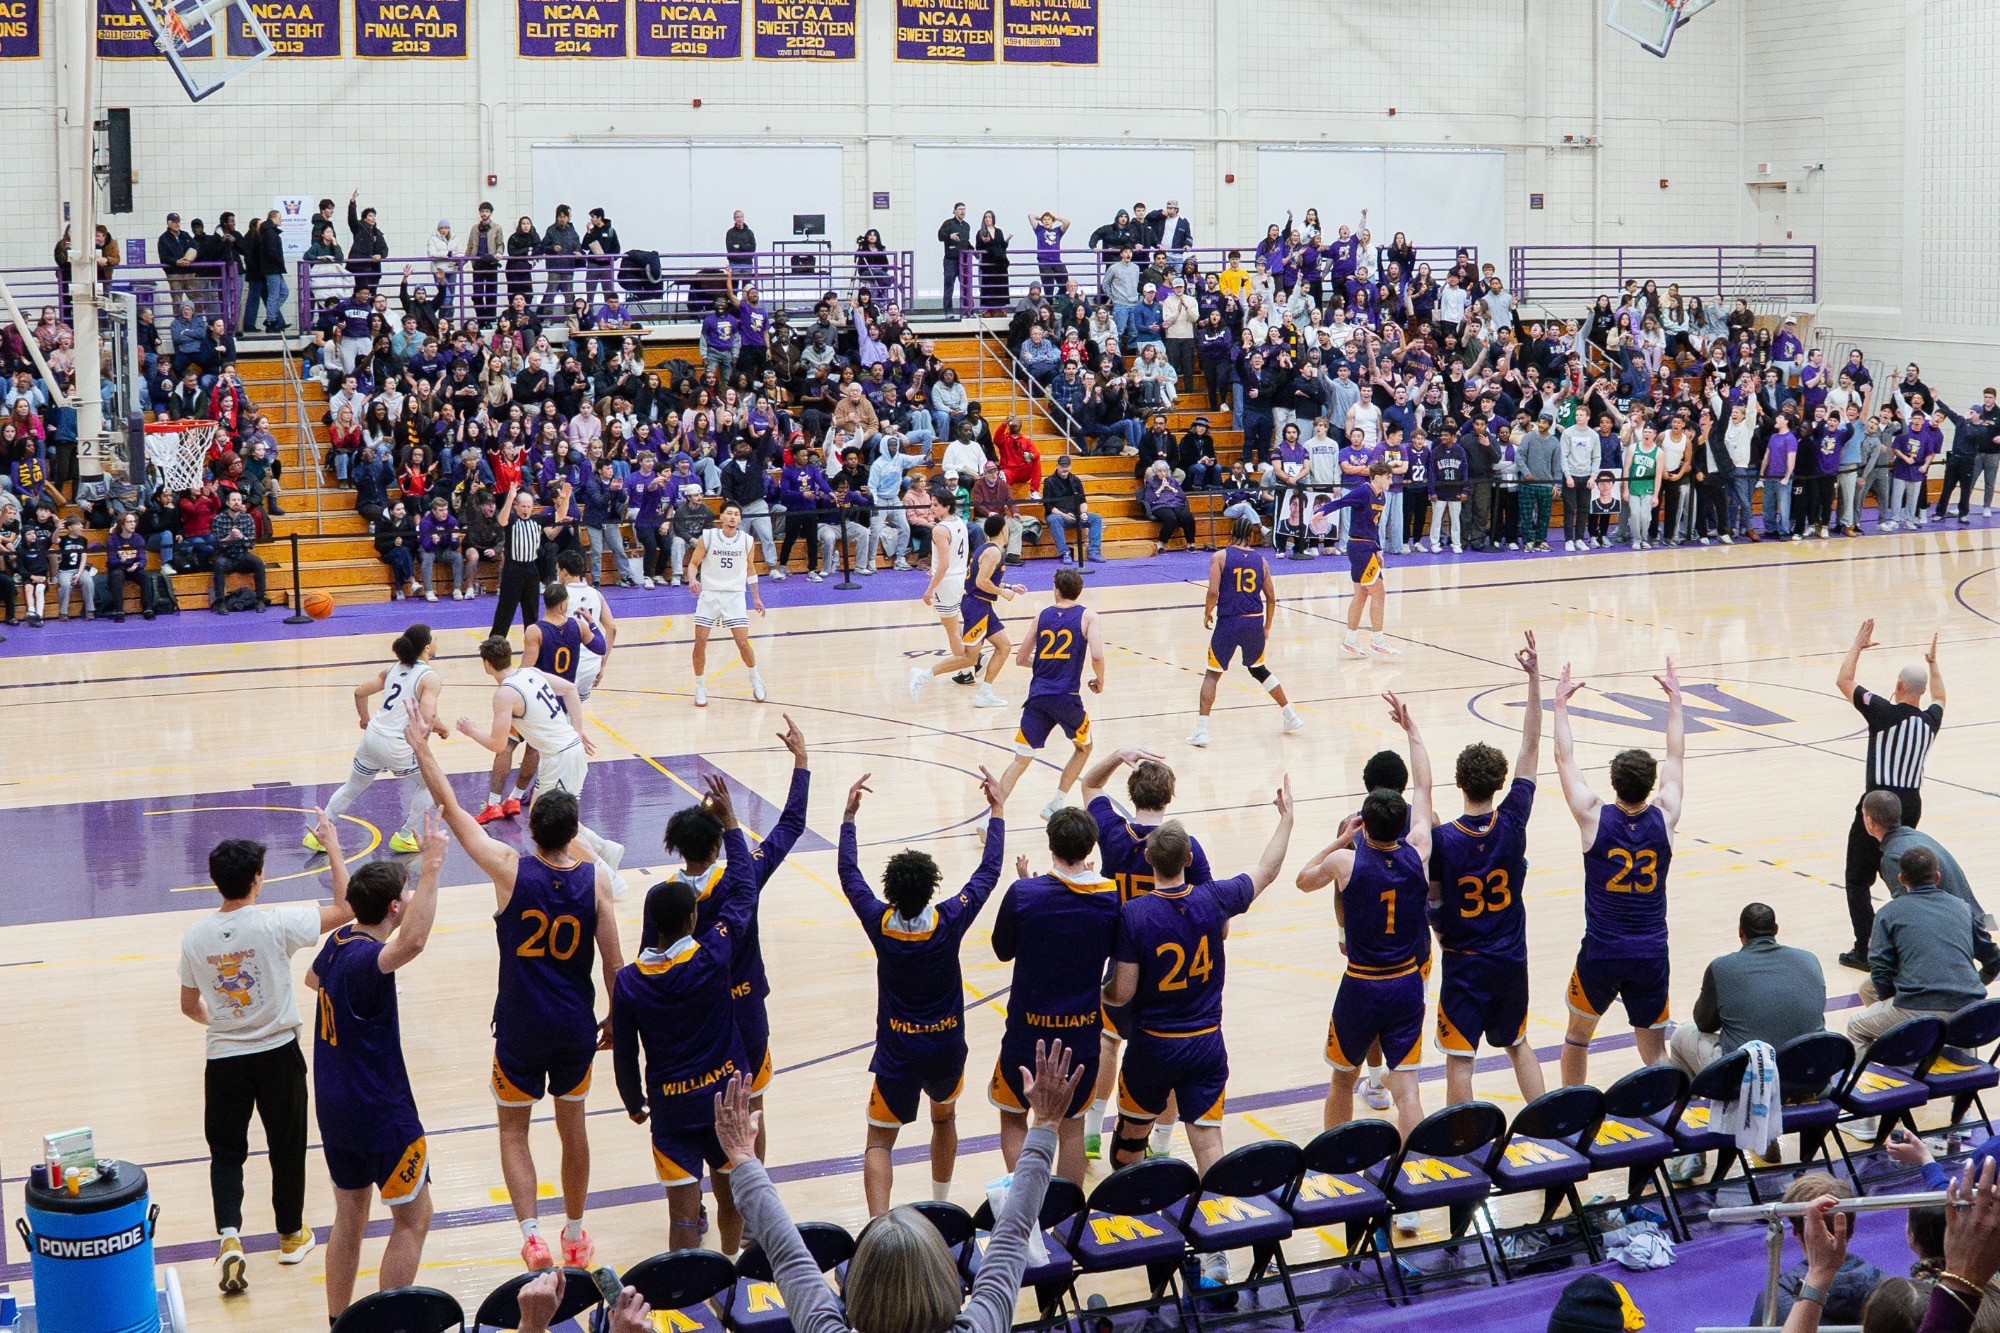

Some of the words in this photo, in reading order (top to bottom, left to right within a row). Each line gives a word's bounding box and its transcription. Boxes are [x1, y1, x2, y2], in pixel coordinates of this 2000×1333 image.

[253, 4, 314, 20] NCAA
[379, 5, 441, 20] NCAA
[544, 5, 600, 20] NCAA
[661, 6, 717, 21] NCAA
[777, 6, 833, 21] NCAA
[918, 11, 973, 27] NCAA
[1030, 10, 1071, 22] NCAA
[122, 31, 142, 39] 2014
[286, 23, 324, 38] EIGHT
[365, 23, 410, 38] FINAL
[415, 23, 457, 38] FOUR
[526, 23, 571, 38] ELITE
[574, 23, 618, 38] EIGHT
[651, 25, 688, 39] ELITE
[691, 25, 727, 40] EIGHT
[757, 20, 798, 35] SWEET
[802, 21, 854, 36] SIXTEEN
[898, 27, 939, 42] SWEET
[943, 29, 993, 44] SIXTEEN
[1007, 23, 1095, 36] TOURNAMENT
[392, 41, 430, 52] 2013
[555, 41, 591, 53] 2014
[671, 42, 708, 54] 2019
[786, 37, 825, 48] 2020
[927, 46, 965, 57] 2022
[82, 441, 92, 456] 2
[1636, 465, 1646, 477] 0
[712, 549, 742, 557] AMHERST
[957, 538, 964, 559] 4
[69, 553, 78, 566] 3
[720, 557, 733, 569] 55
[1232, 567, 1257, 593] 13
[1039, 629, 1073, 660] 22
[554, 646, 571, 674] 0
[383, 683, 402, 711] 2
[536, 683, 563, 719] 15
[1605, 848, 1658, 893] 23
[1457, 868, 1512, 919] 33
[1379, 889, 1397, 935] 1
[516, 909, 581, 960] 20
[1156, 935, 1213, 992] 24
[889, 1015, 958, 1035] WILLIAMS
[1025, 1010, 1098, 1029] WILLIAMS
[662, 1059, 735, 1097] WILLIAMS
[400, 1150, 421, 1183] Ephs
[39, 1226, 143, 1258] POWERADE
